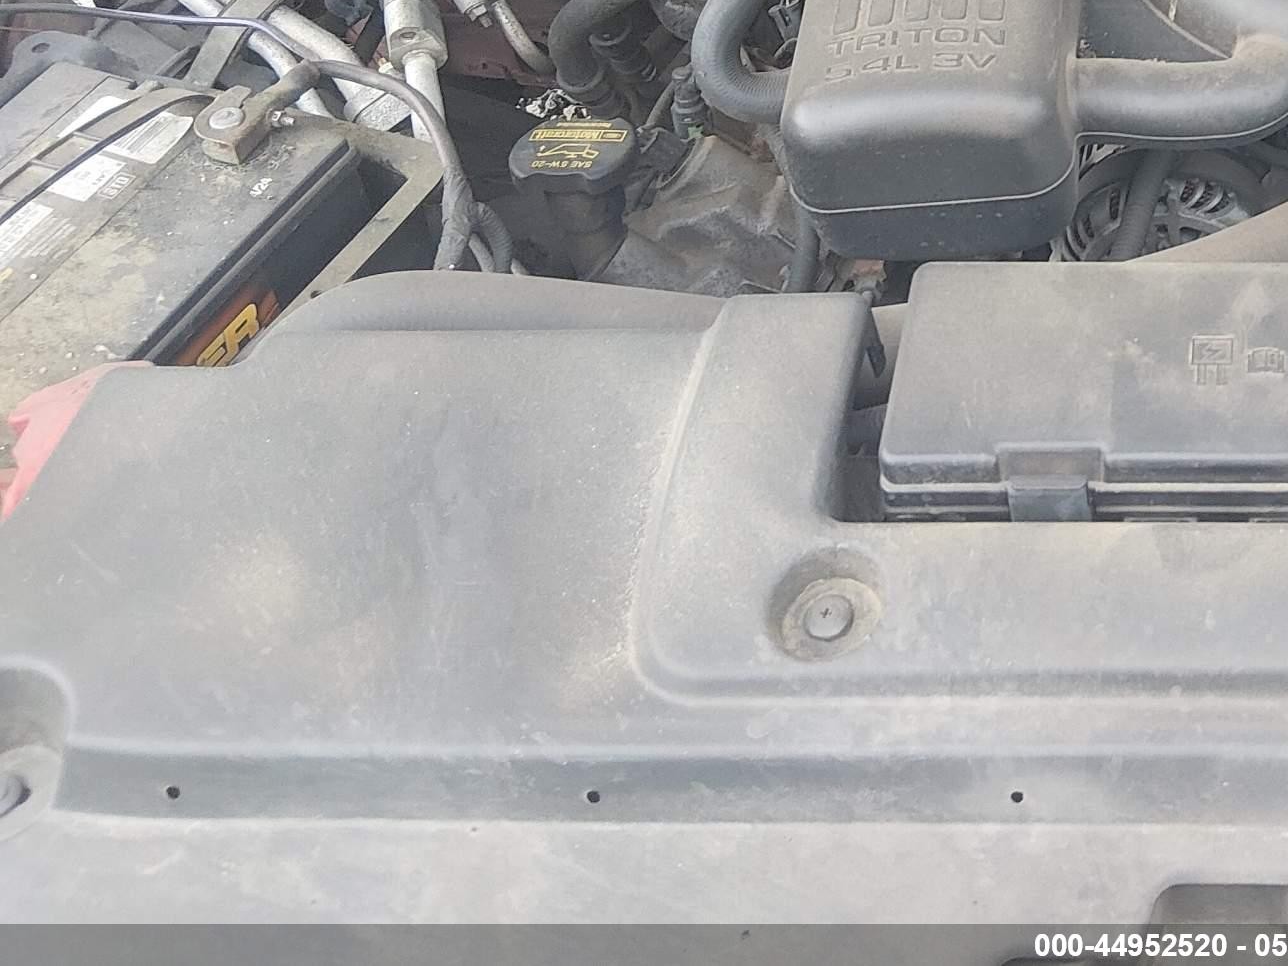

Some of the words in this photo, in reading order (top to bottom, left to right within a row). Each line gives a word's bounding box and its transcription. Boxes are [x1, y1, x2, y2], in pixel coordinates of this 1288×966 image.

[825, 27, 1006, 56] TRITON
[933, 52, 997, 69] 3V
[531, 160, 568, 169] 5W-20
[570, 160, 593, 169] SAE
